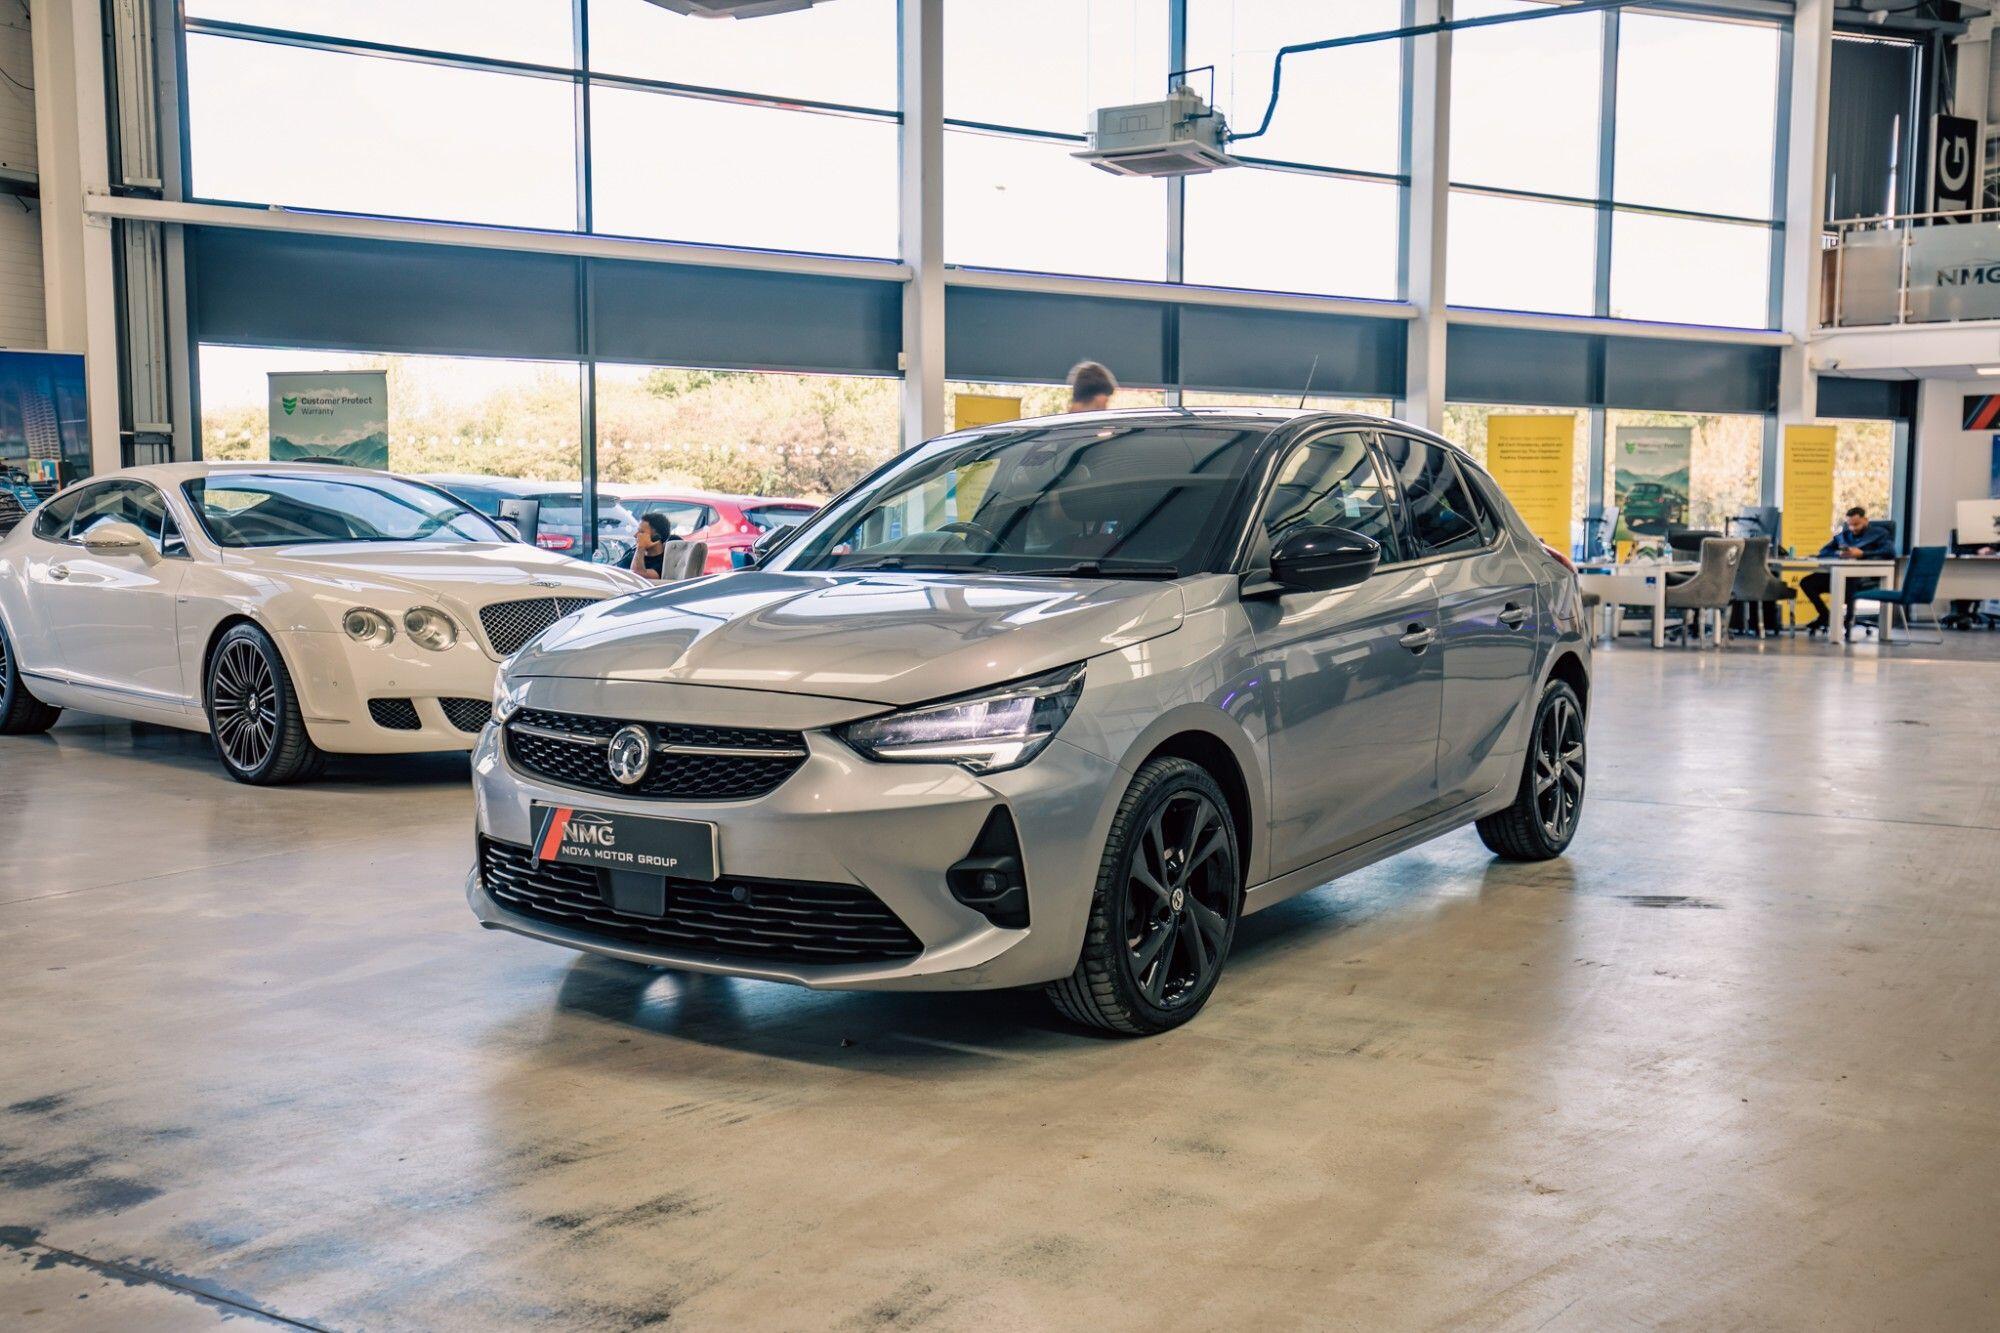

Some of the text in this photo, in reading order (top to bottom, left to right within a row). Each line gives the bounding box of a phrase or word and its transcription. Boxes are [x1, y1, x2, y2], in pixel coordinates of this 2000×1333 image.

[1937, 267, 2000, 286] NMG
[301, 396, 372, 405] Customer Protect
[301, 408, 335, 416] Warranty
[561, 822, 615, 846] NMG
[562, 845, 678, 867] NOYA MOTOR GROUP
